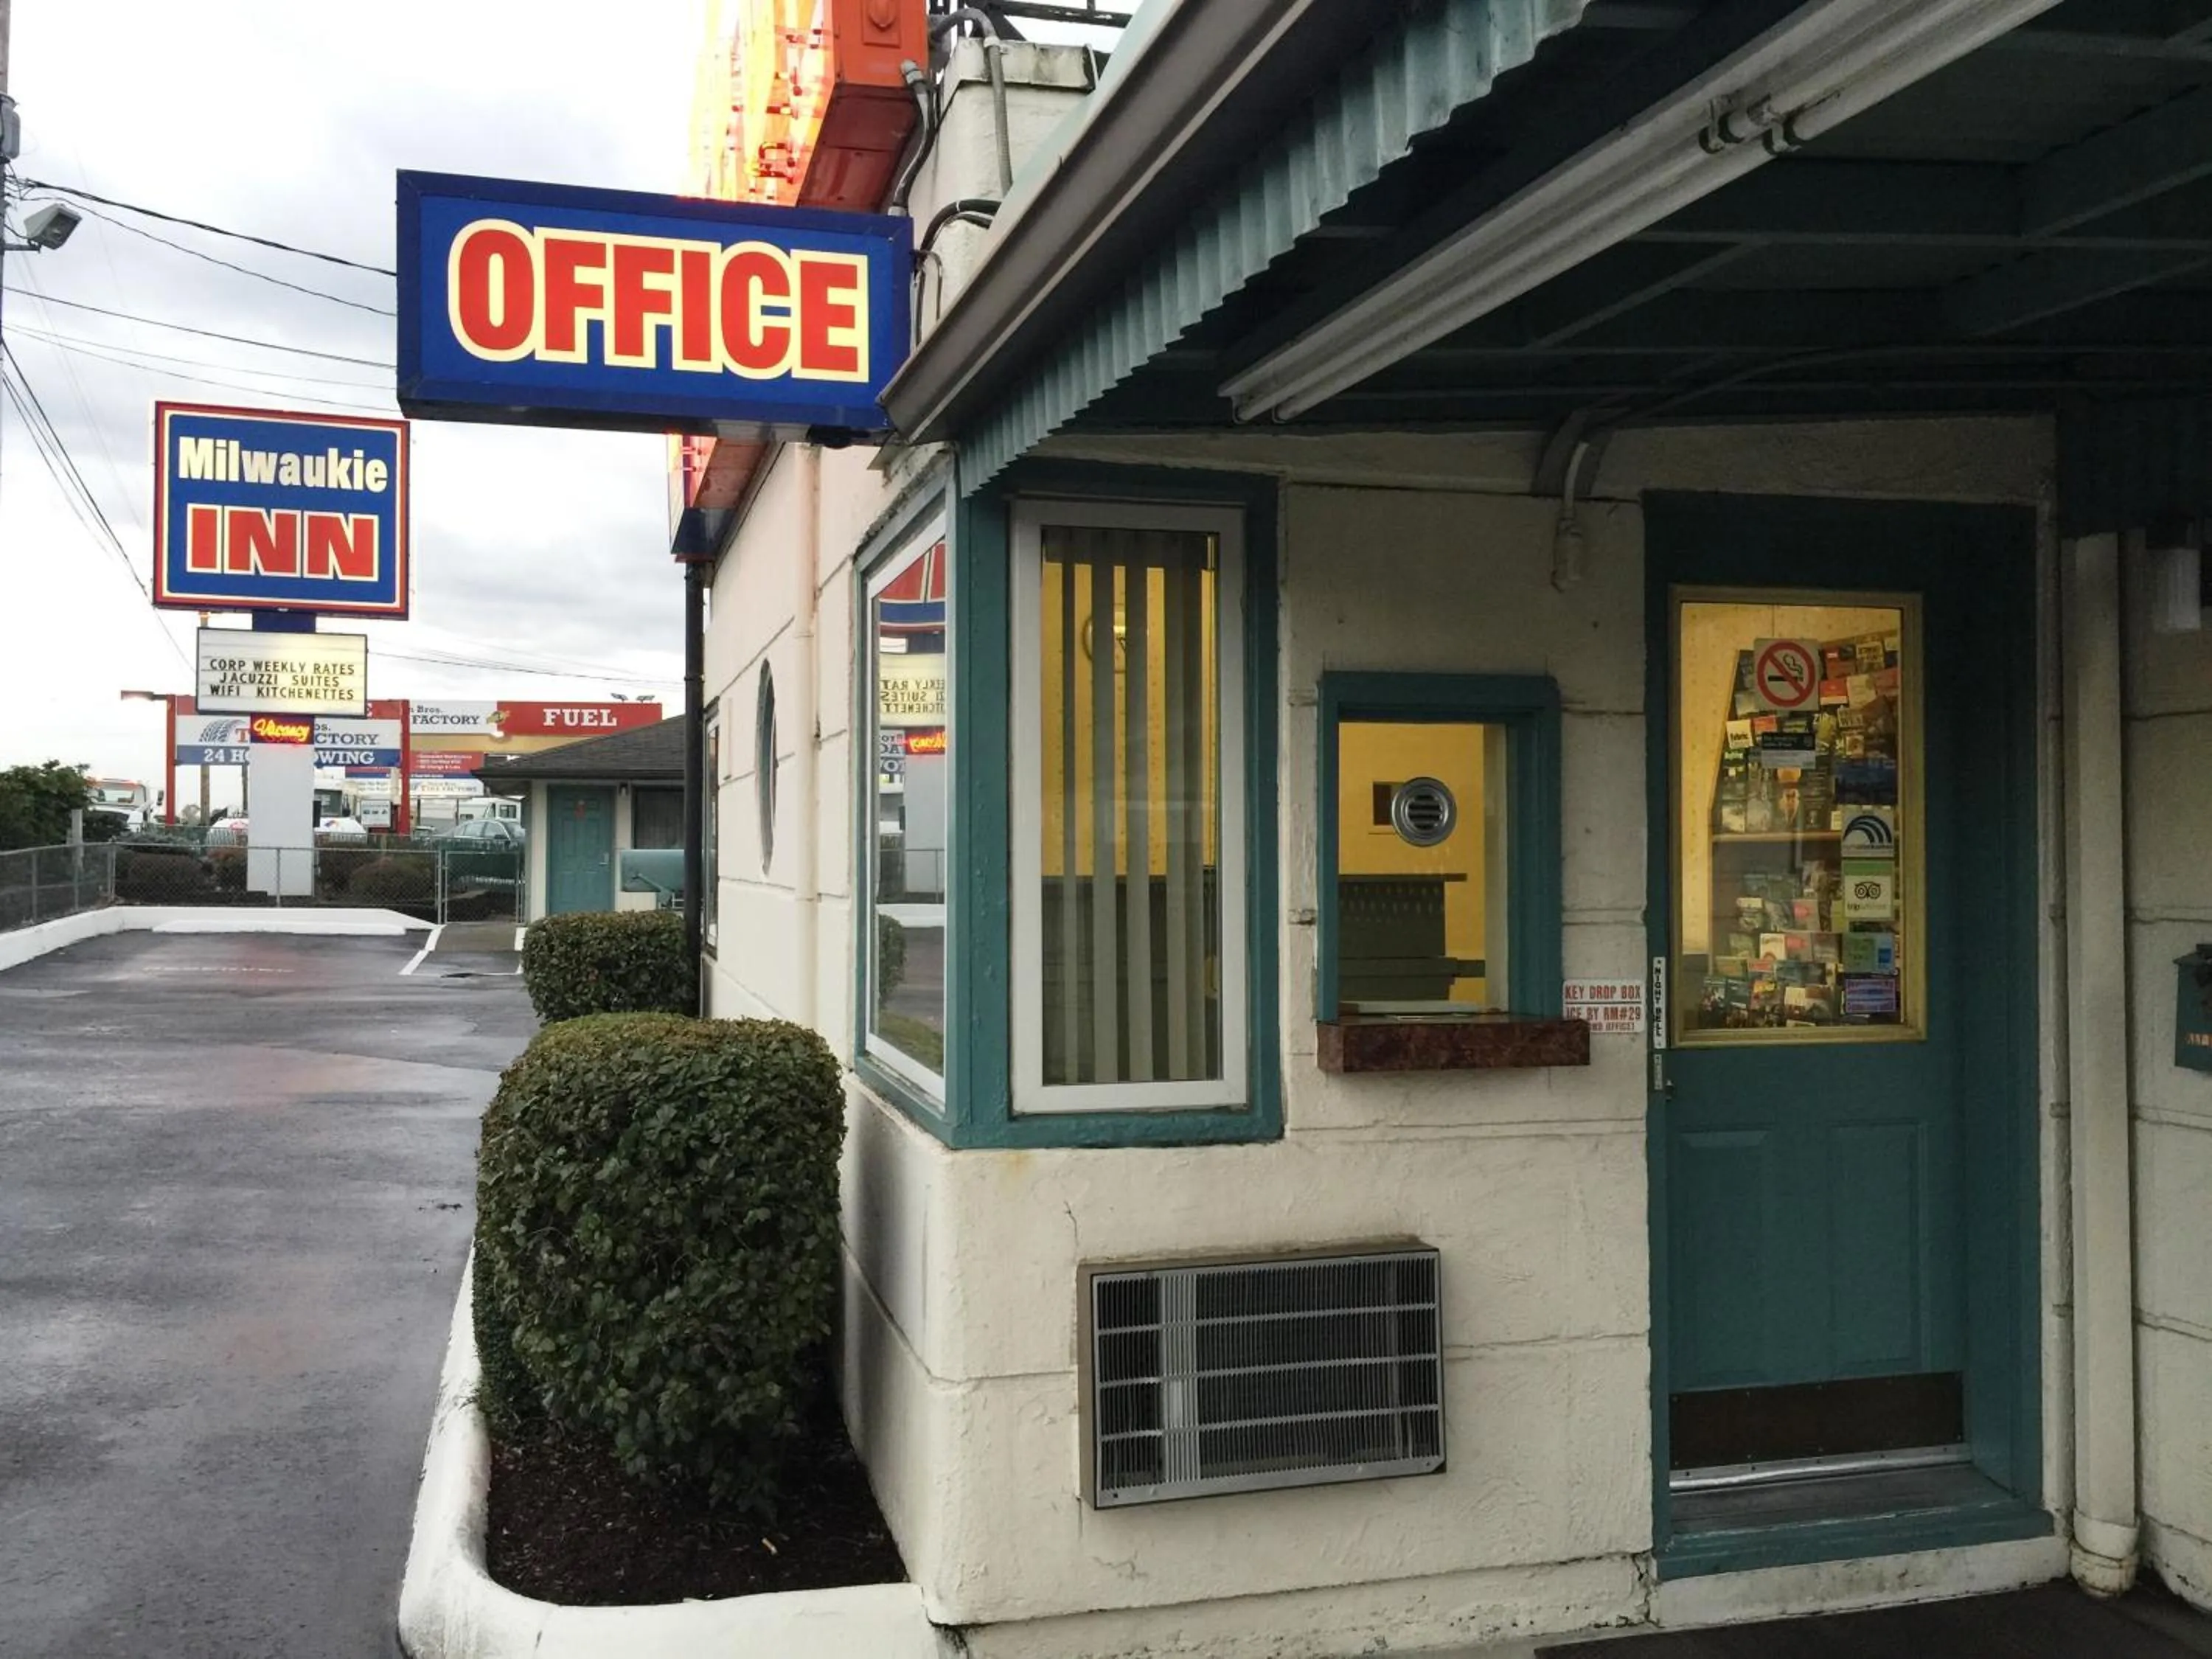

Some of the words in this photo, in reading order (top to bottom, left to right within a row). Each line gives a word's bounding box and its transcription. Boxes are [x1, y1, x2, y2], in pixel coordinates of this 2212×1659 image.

[448, 219, 869, 382] OFFICE
[178, 437, 388, 493] Milwaukie
[187, 503, 378, 581] INN
[209, 658, 246, 671] CORP
[253, 661, 307, 672] WEEKLY
[313, 663, 355, 675] RATES
[219, 672, 278, 684] JACUZZI
[291, 675, 340, 687] SUITES
[210, 684, 240, 697] WIFI
[256, 686, 354, 700] KITCHENETTES
[412, 714, 480, 725] FACTORY
[543, 709, 617, 726] FUEL
[253, 717, 310, 742] Vacancy
[315, 733, 379, 745] CTORY
[204, 749, 224, 762] 24
[315, 750, 375, 765] WING
[1565, 986, 1585, 1000] KEY
[1589, 985, 1616, 999] DROP
[1621, 985, 1641, 999] BOX
[1587, 1007, 1599, 1021] BY
[1603, 1006, 1641, 1021] RM#29
